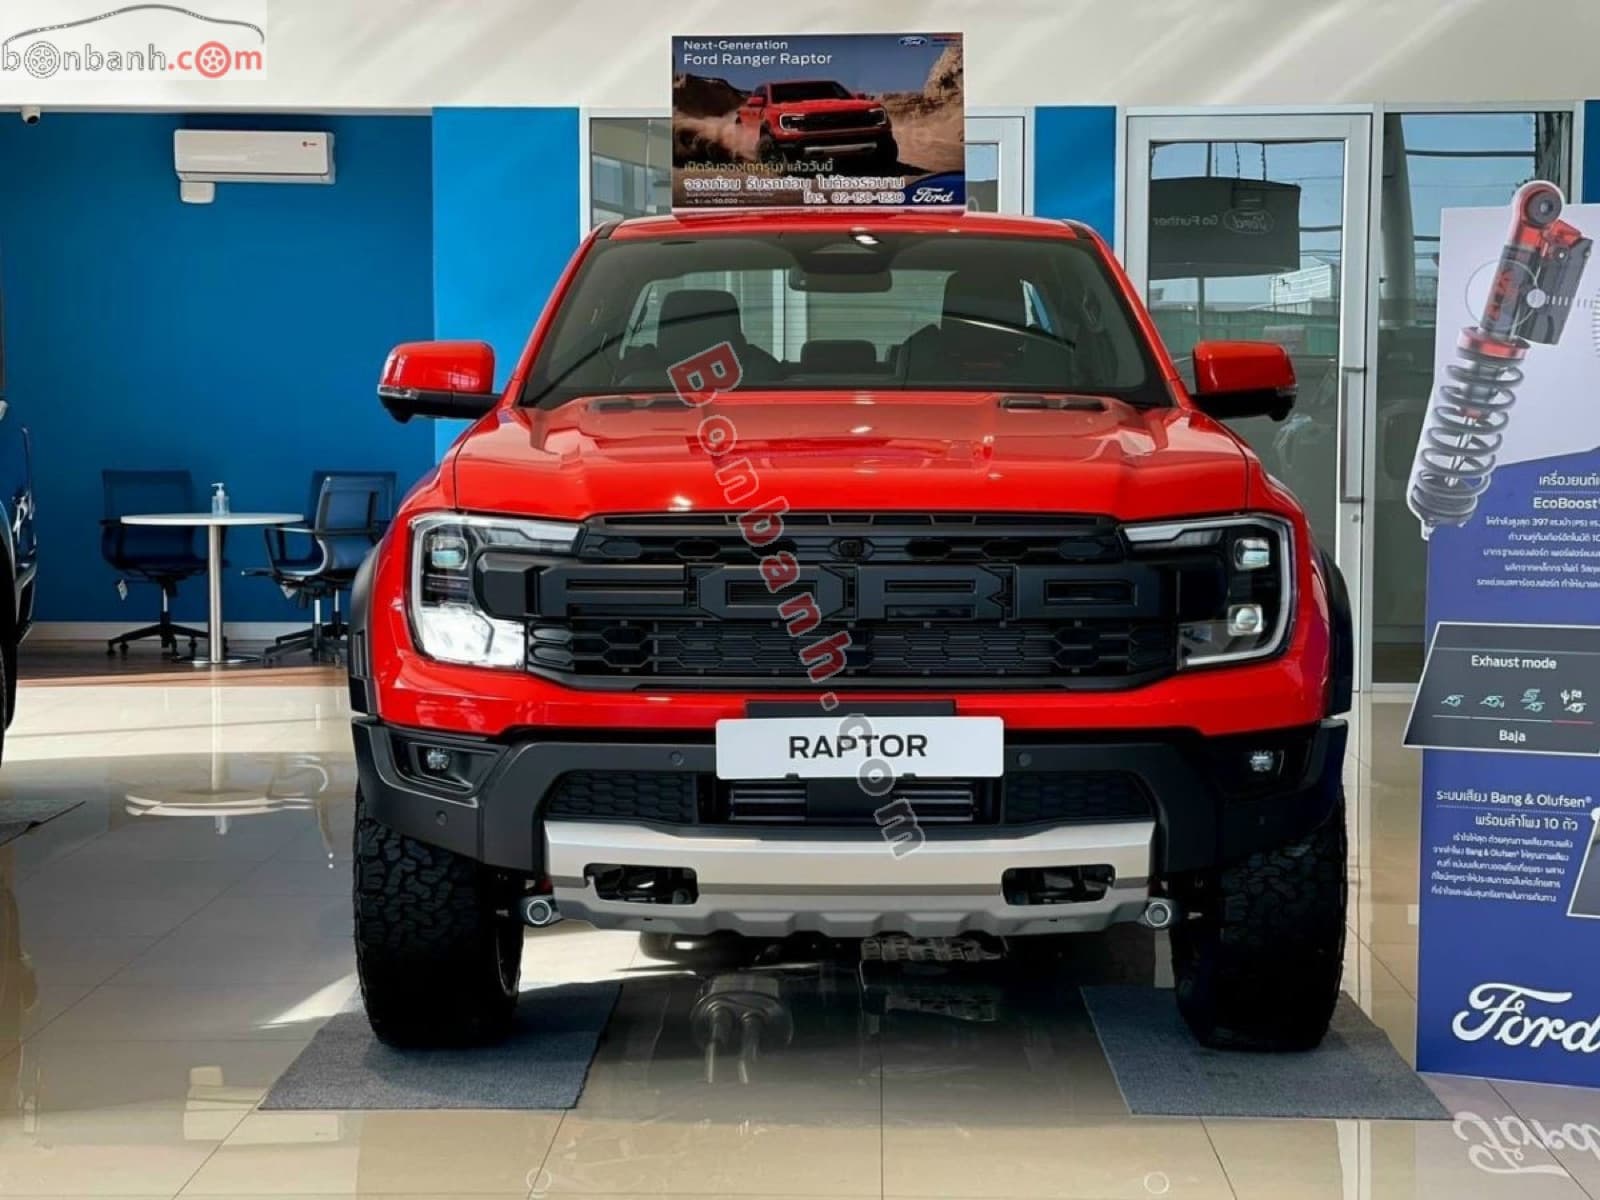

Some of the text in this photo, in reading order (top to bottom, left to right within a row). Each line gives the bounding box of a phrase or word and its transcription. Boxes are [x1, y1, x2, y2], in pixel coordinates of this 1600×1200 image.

[683, 40, 788, 51] Next-Generation
[684, 52, 833, 68] Ford Ranger Raptor
[911, 186, 953, 203] Ford
[1471, 654, 1557, 669] Exhaust mode
[1499, 729, 1526, 744] Baja
[788, 734, 928, 759] RAPTOR
[1491, 791, 1522, 807] Bang
[1524, 793, 1535, 805] &
[1544, 817, 1559, 830] 10
[1562, 816, 1579, 832] ตัว
[1452, 983, 1600, 1053] Ford
